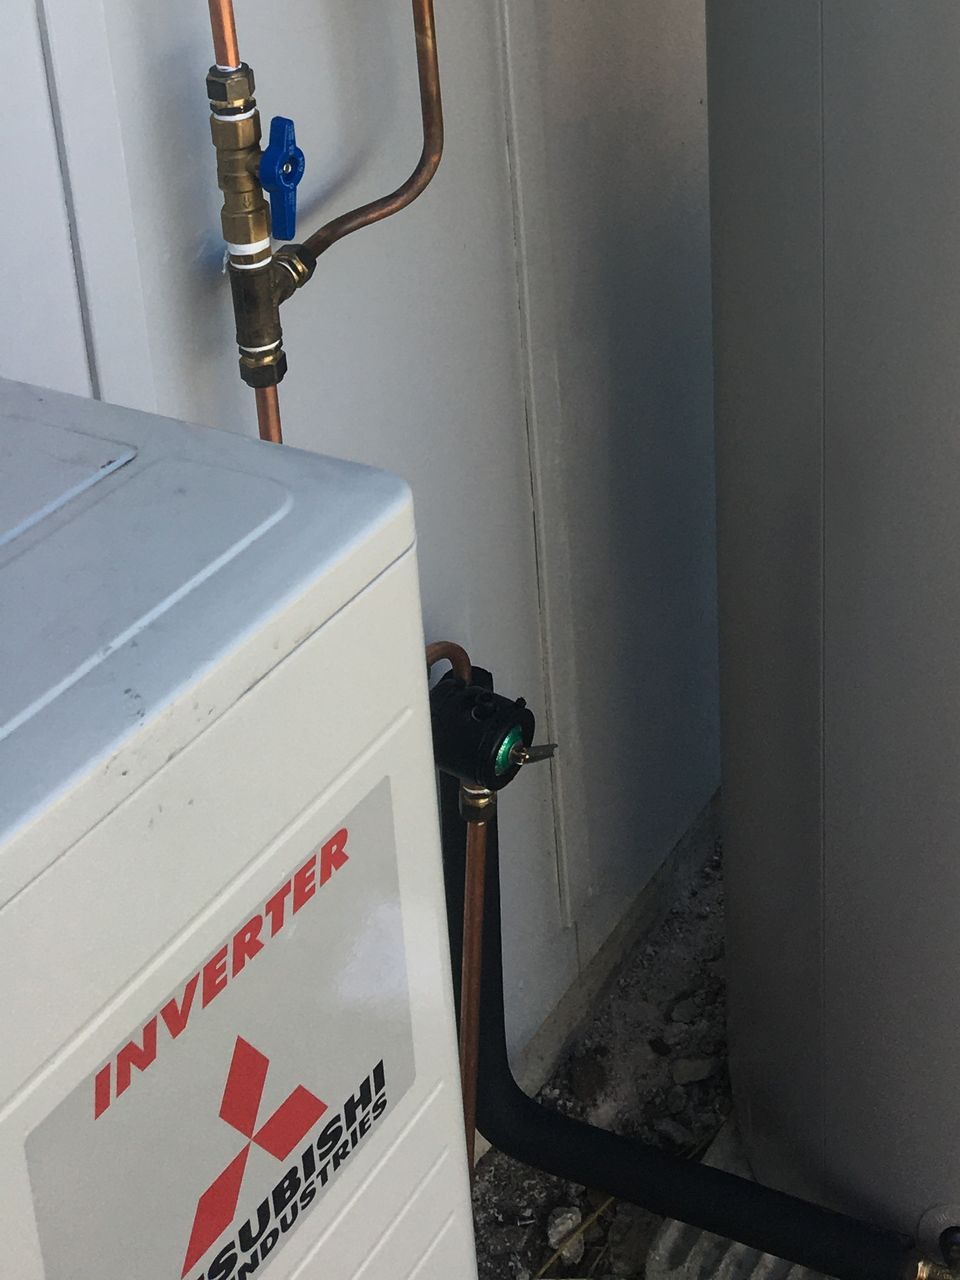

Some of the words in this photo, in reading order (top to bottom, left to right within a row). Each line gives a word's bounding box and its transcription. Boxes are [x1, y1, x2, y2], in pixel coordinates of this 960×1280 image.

[93, 827, 350, 1121] INVERTER
[197, 1059, 386, 1280] SUBISHI
[230, 1091, 388, 1280] NDUSTRIES
